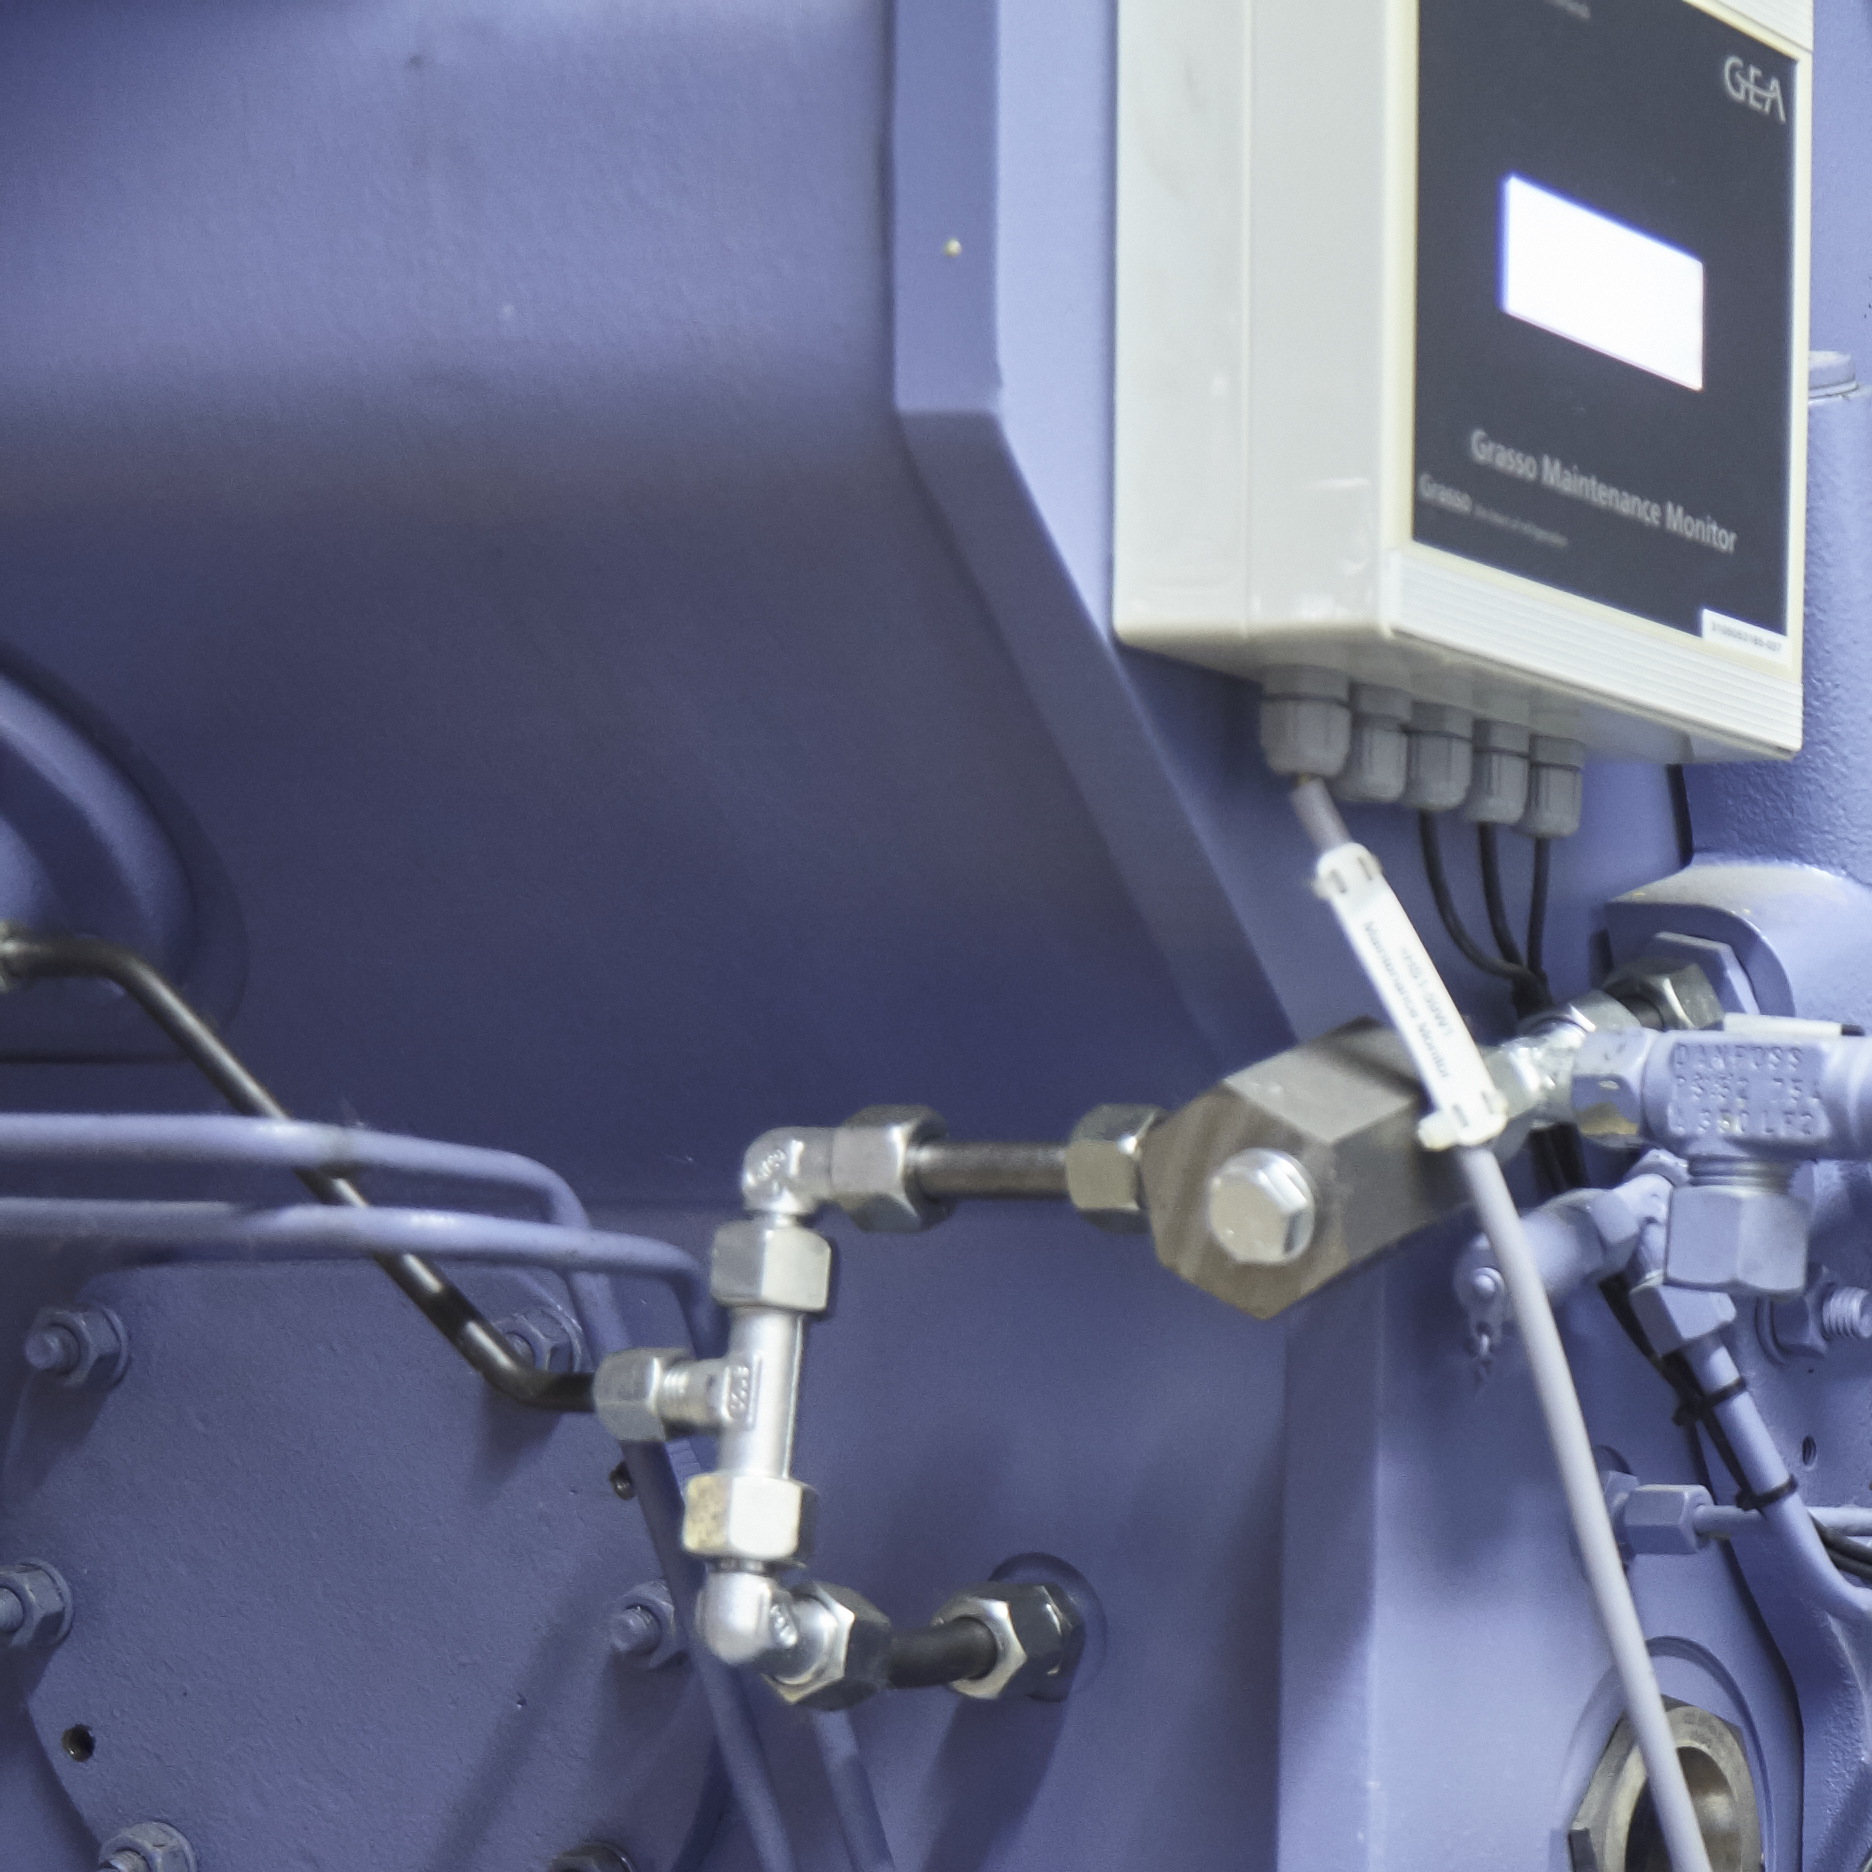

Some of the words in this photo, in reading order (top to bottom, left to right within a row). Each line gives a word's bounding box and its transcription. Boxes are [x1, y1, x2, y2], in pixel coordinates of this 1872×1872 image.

[1723, 56, 1786, 124] GEA
[1470, 428, 1538, 482] Grasso
[1541, 454, 1662, 527] Maintenance
[1665, 500, 1738, 555] Monitor
[1674, 1043, 1803, 1071] DANFOSS
